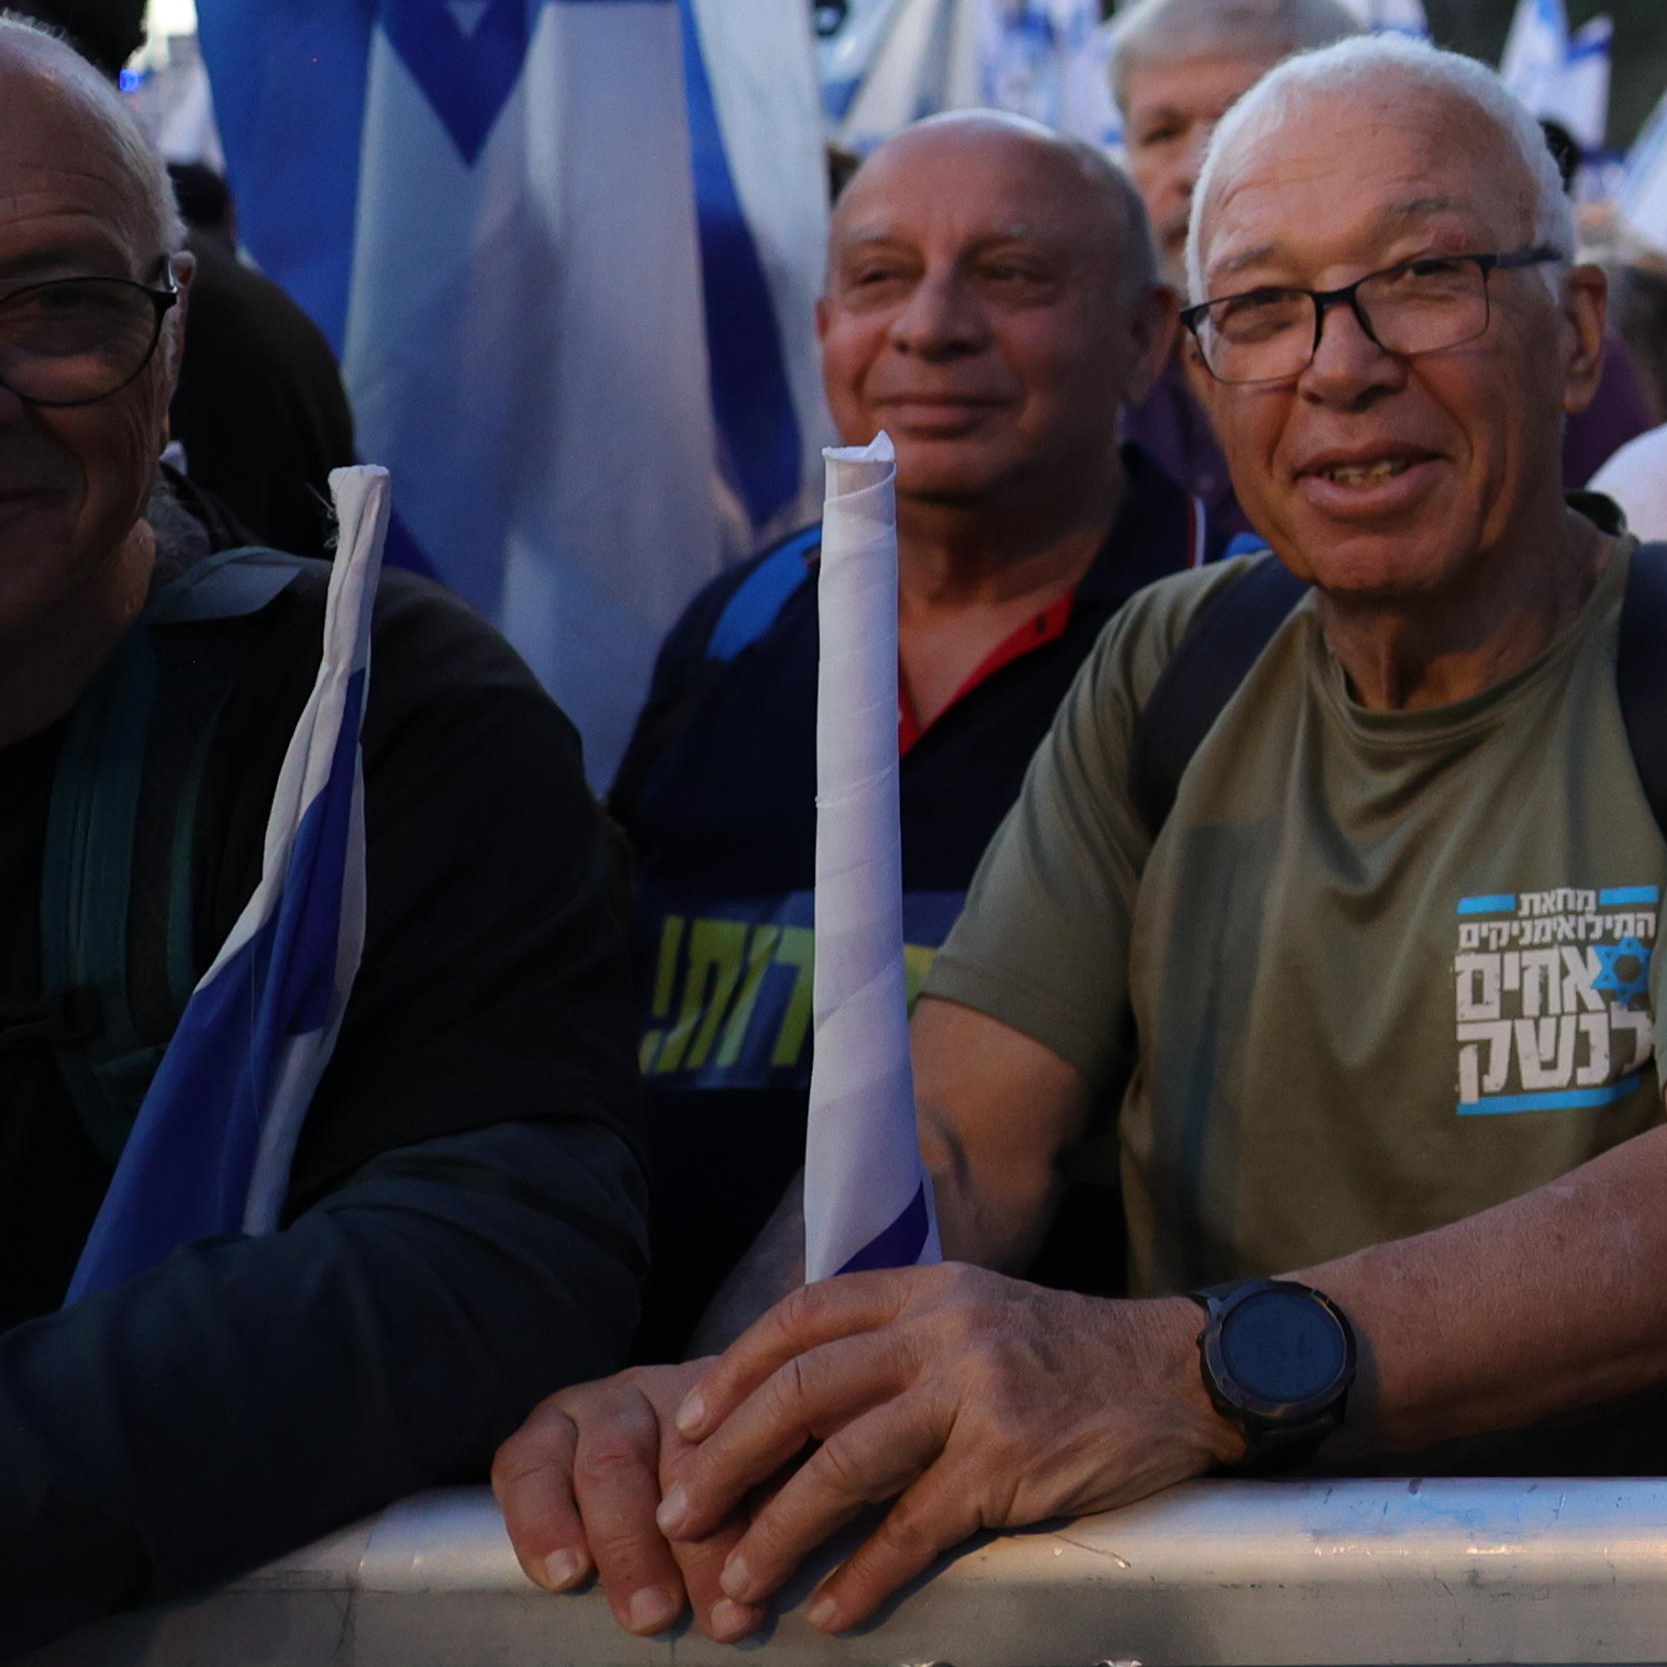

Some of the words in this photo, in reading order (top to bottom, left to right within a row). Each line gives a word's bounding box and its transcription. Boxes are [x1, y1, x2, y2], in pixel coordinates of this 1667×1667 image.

[1518, 886, 1598, 917] מחאת
[1453, 943, 1606, 1022] אחים
[1456, 1002, 1655, 1104] לנשק
